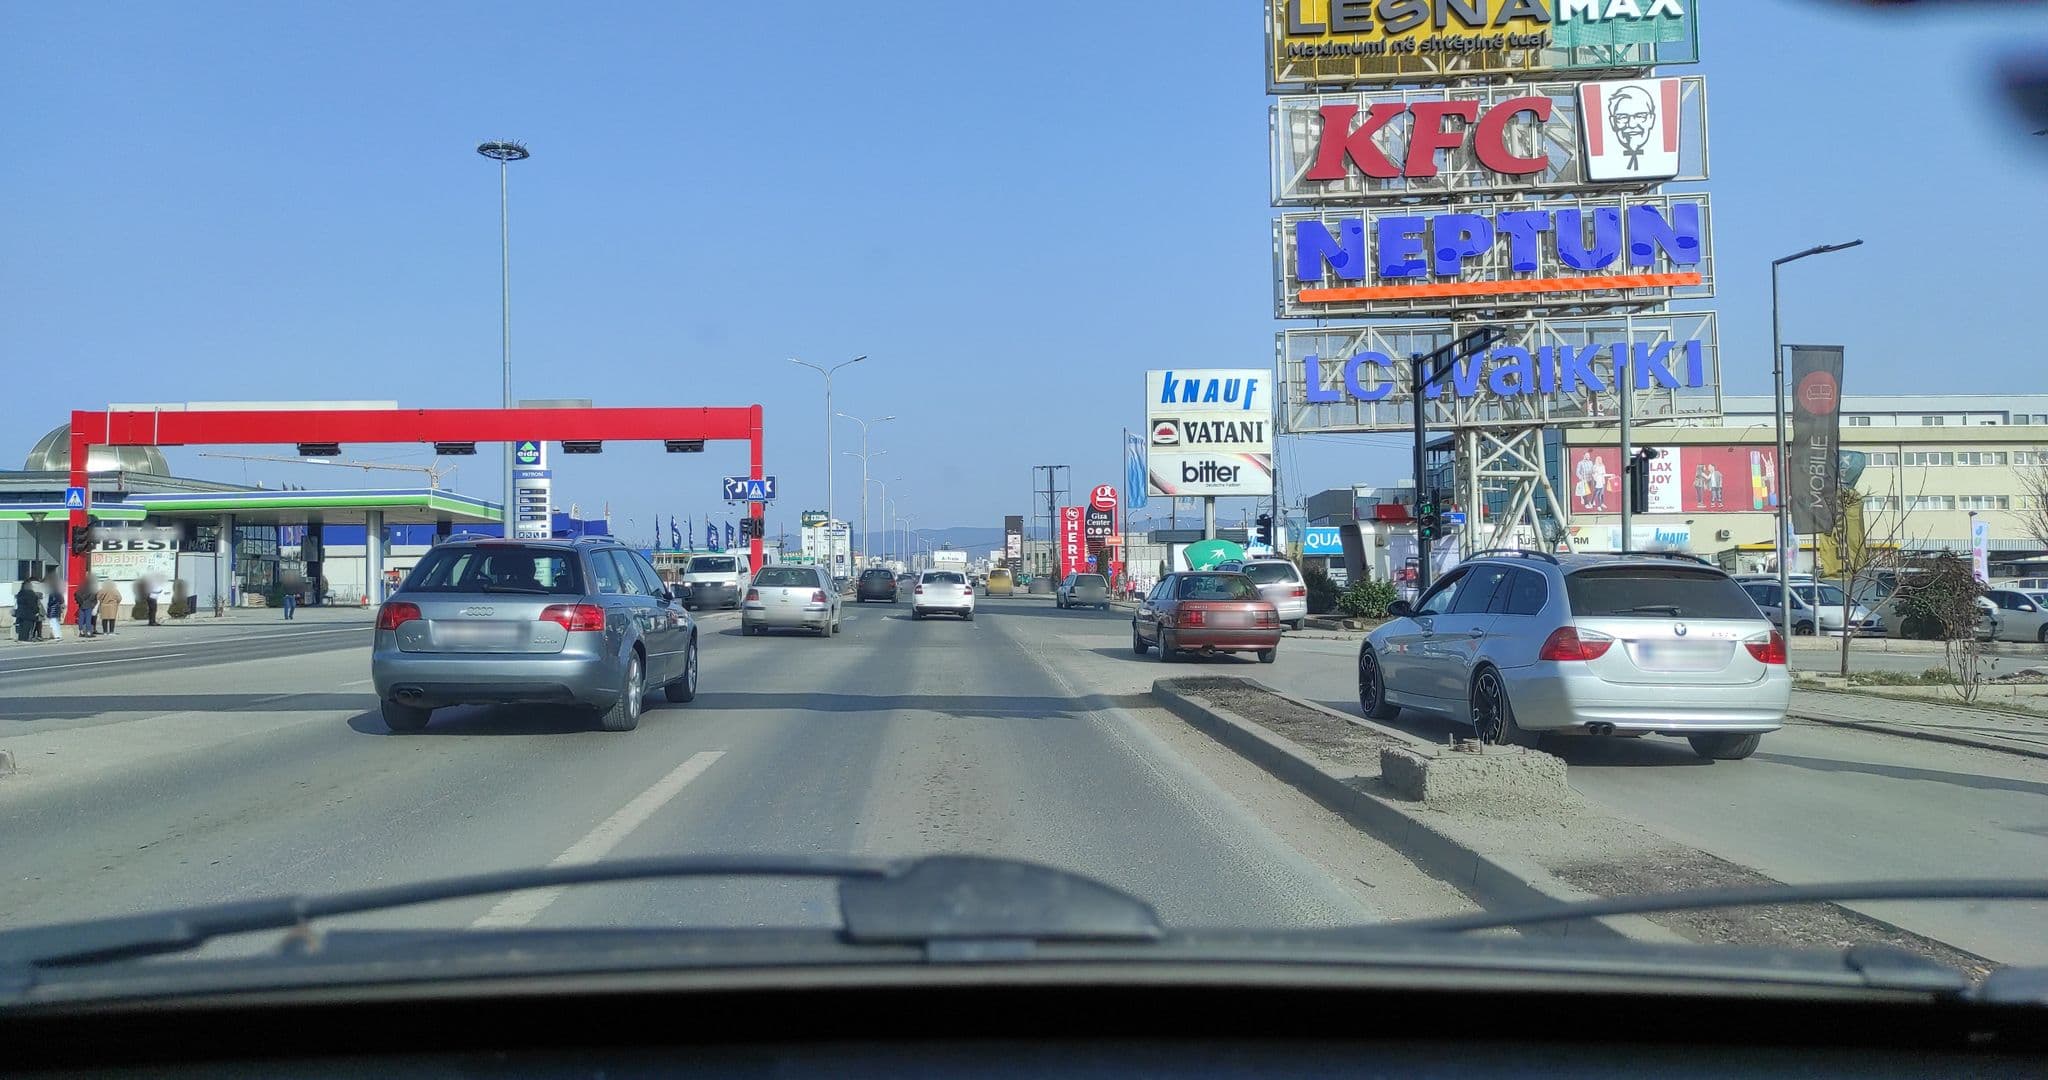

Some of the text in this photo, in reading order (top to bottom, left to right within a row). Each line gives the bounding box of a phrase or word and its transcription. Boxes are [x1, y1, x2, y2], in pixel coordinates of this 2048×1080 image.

[1286, 0, 1550, 35] LESNA
[1306, 96, 1553, 181] KFC
[1296, 202, 1702, 281] NEPTUN
[1304, 351, 1395, 404] LC
[1182, 461, 1240, 483] bitter
[1809, 434, 1828, 508] MOBILIE
